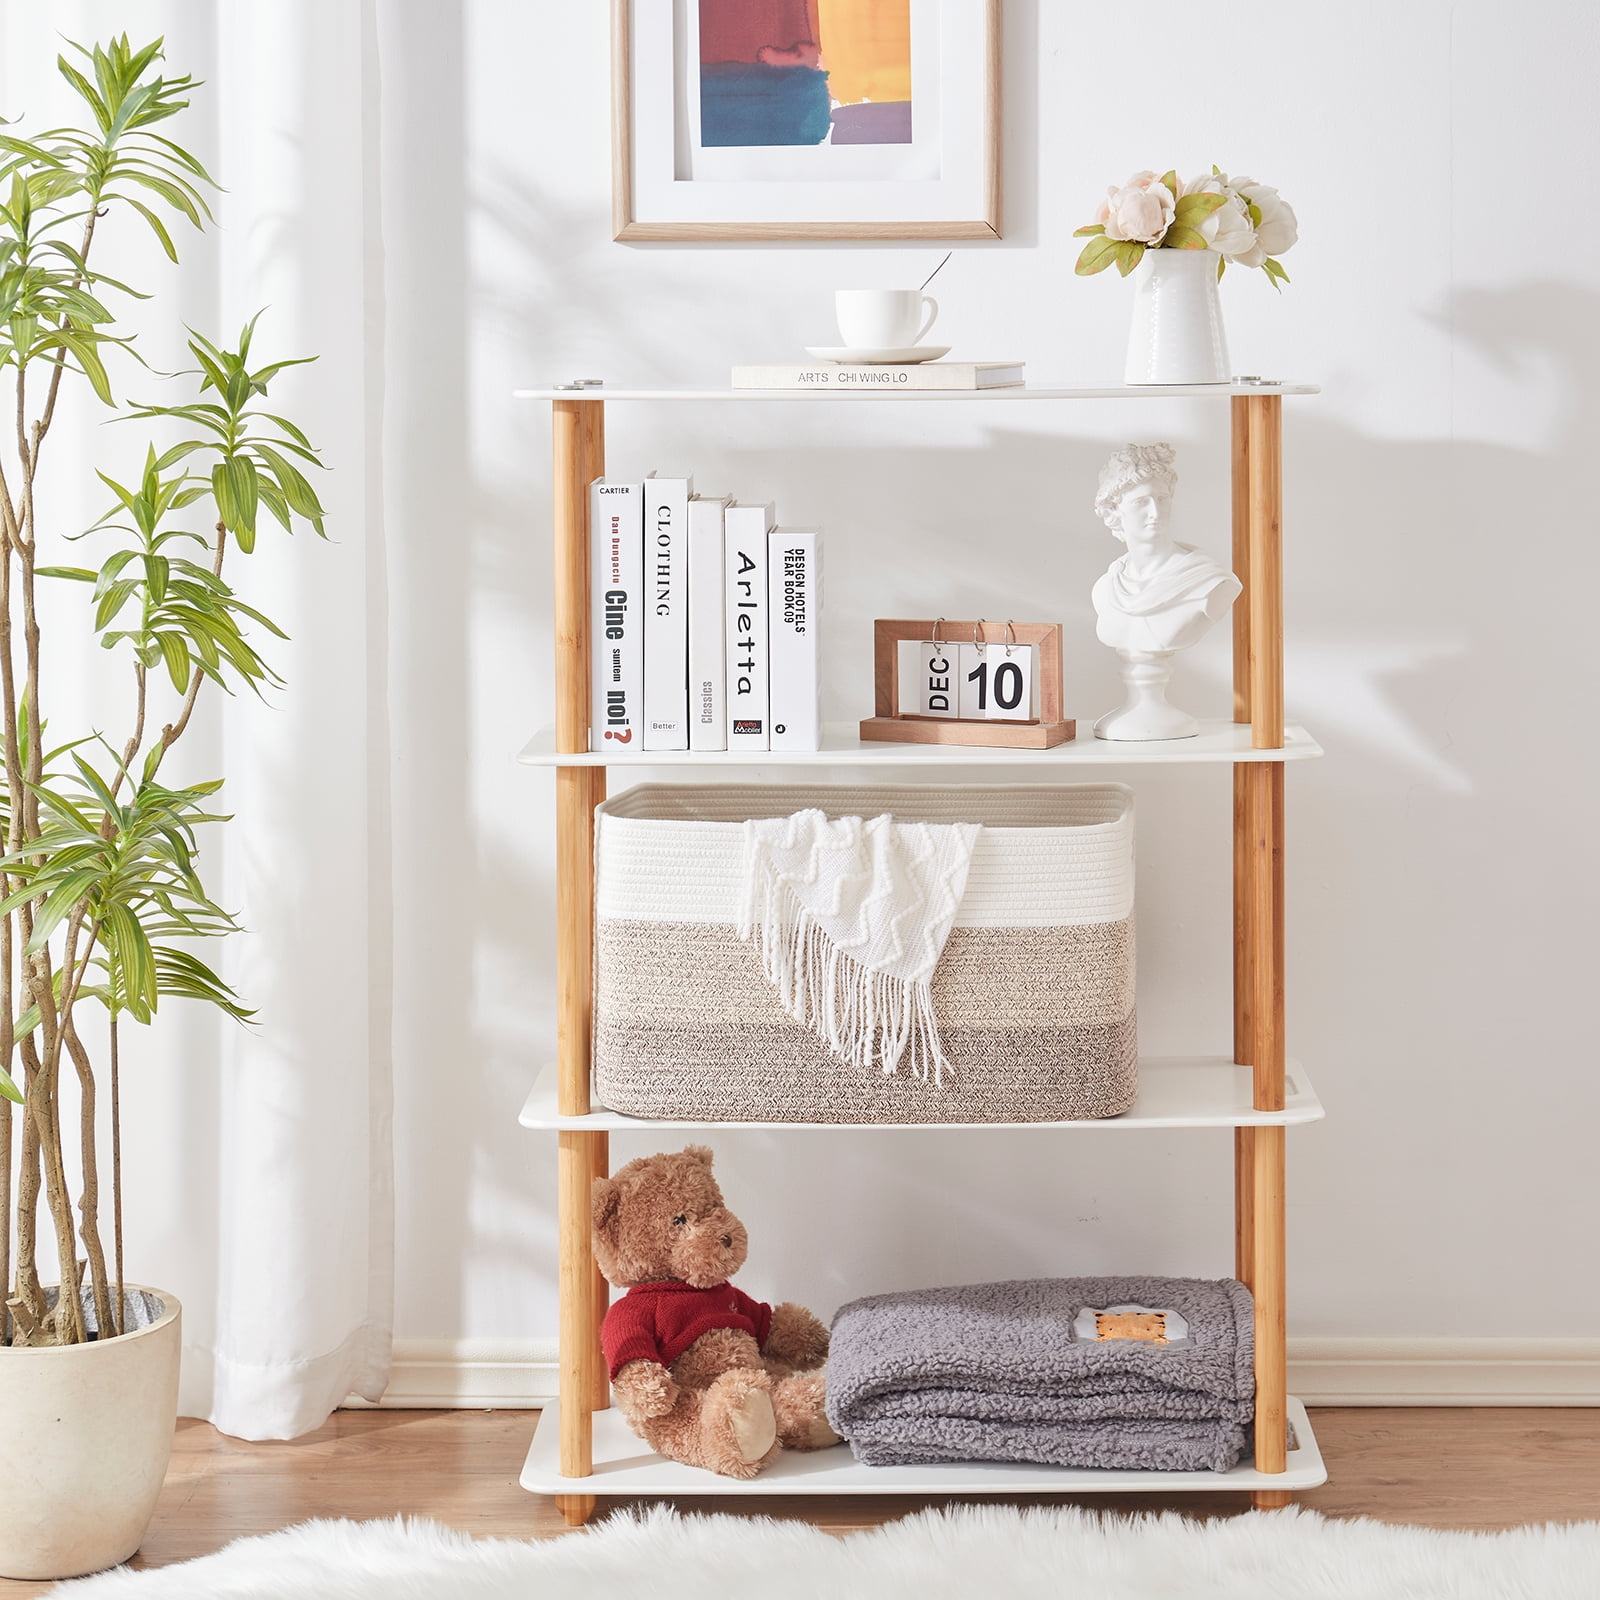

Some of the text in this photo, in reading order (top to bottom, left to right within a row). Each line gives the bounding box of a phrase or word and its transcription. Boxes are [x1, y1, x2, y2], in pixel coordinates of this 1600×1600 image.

[797, 372, 908, 383] ARTS CHI WING LO
[599, 487, 630, 495] CARTIER
[611, 516, 620, 535] Dan
[656, 505, 672, 617] CLOTHING
[784, 548, 795, 577] YEAR
[795, 548, 806, 633] DESIGN HOTELS
[604, 590, 628, 640] Cine
[737, 550, 758, 696] Arletta
[612, 648, 622, 683] suntem
[928, 657, 950, 711] DEC
[968, 662, 1023, 710] 10
[700, 681, 713, 724] Classics
[652, 722, 676, 730] Better
